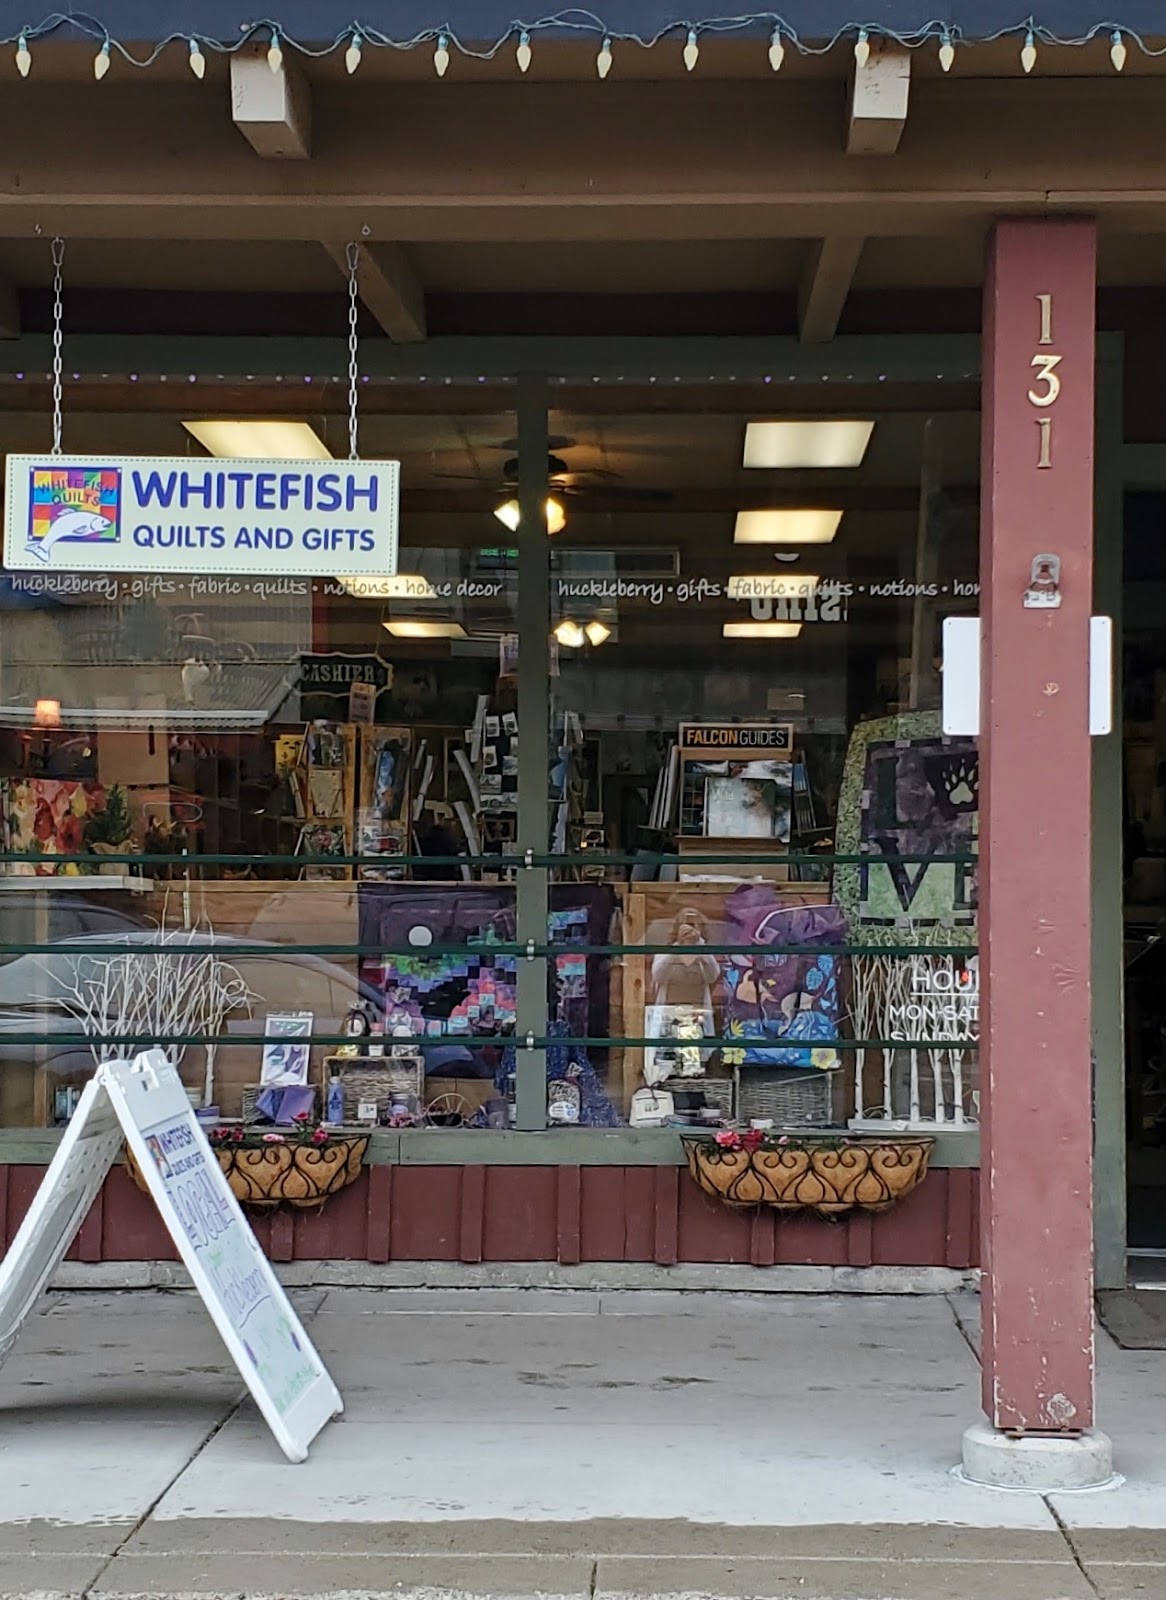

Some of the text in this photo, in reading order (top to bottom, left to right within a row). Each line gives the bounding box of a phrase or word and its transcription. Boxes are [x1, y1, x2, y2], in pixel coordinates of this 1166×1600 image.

[38, 478, 116, 497] WHITEFISH
[52, 491, 101, 507] QUILTS
[132, 470, 379, 512] WHITEFISH
[133, 524, 376, 552] QUILTS AND GIFTS
[11, 574, 503, 600] huckleberry gifts fabric quilts notions home decor
[558, 578, 663, 605] huckleberry
[676, 578, 721, 602] gifts
[733, 578, 786, 602] fabric
[798, 578, 853, 601] quilts
[869, 579, 938, 597] notions
[300, 664, 375, 683] CASHIER
[912, 969, 980, 991] HOU
